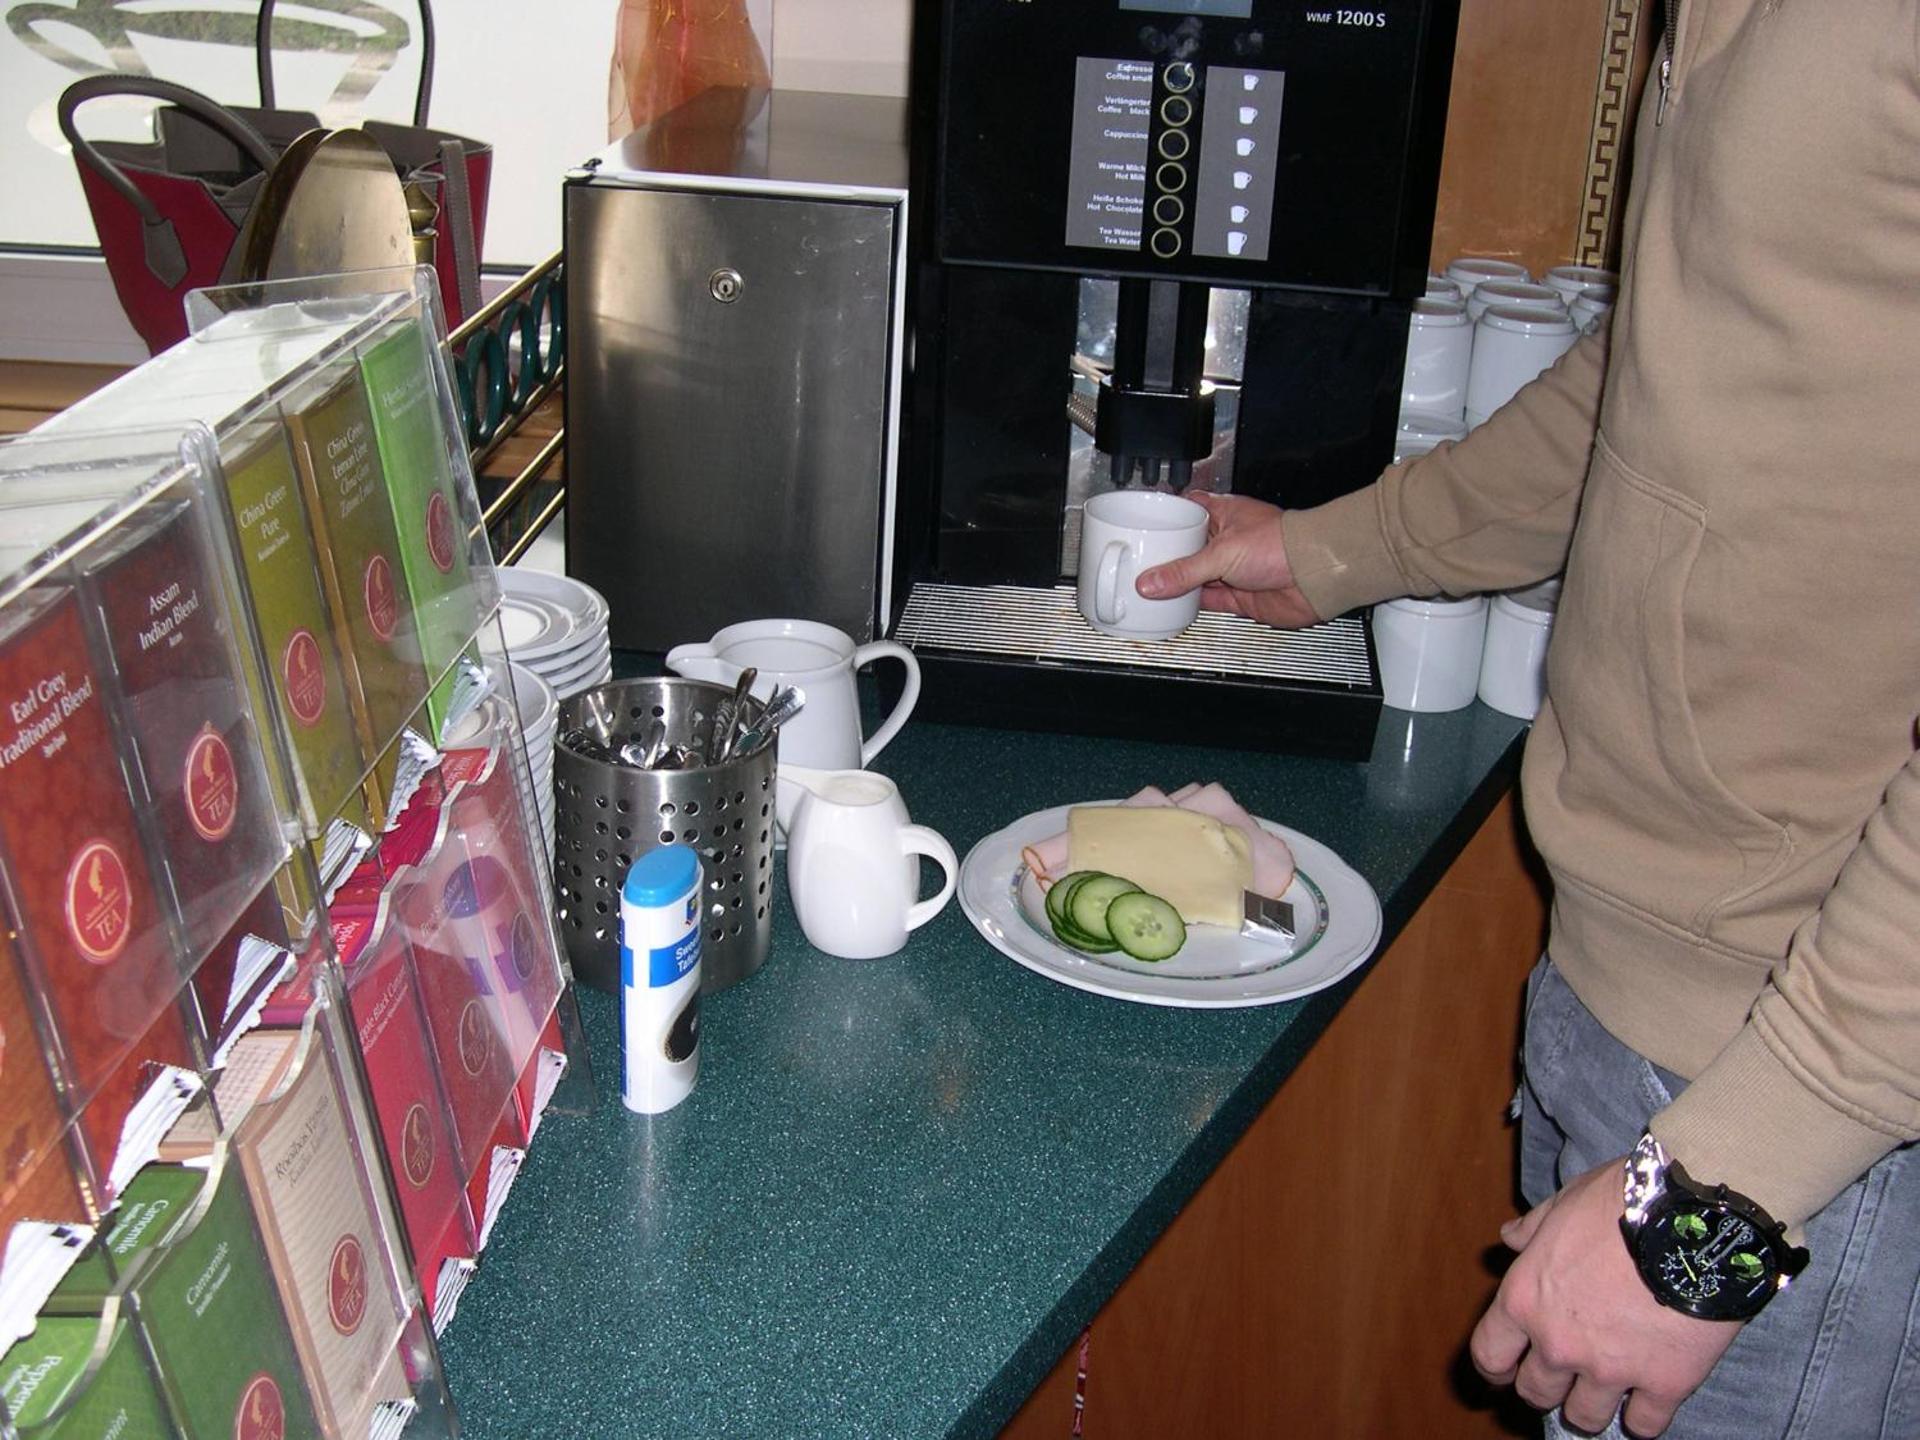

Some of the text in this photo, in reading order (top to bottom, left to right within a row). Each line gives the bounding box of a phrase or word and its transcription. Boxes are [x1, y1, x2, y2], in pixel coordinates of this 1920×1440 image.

[1306, 11, 1332, 23] WMF
[1105, 71, 1131, 81] Coffee
[1097, 104, 1150, 116] Coffee black
[1103, 129, 1149, 141] Cappuccino
[1098, 161, 1146, 173] Warme Milch
[1115, 172, 1129, 180] Hot
[1087, 202, 1143, 214] Hot Chocolate
[240, 503, 266, 529] China
[261, 518, 281, 540] Pure
[148, 582, 181, 616] Assam
[139, 619, 174, 651] Indian
[172, 589, 199, 625] Blend
[10, 671, 67, 725] Earl Grey
[60, 674, 93, 718] Blend
[209, 792, 231, 821] TEA
[96, 908, 123, 941] TEA
[114, 1199, 170, 1254] Camomile
[187, 1240, 229, 1306] Camomile
